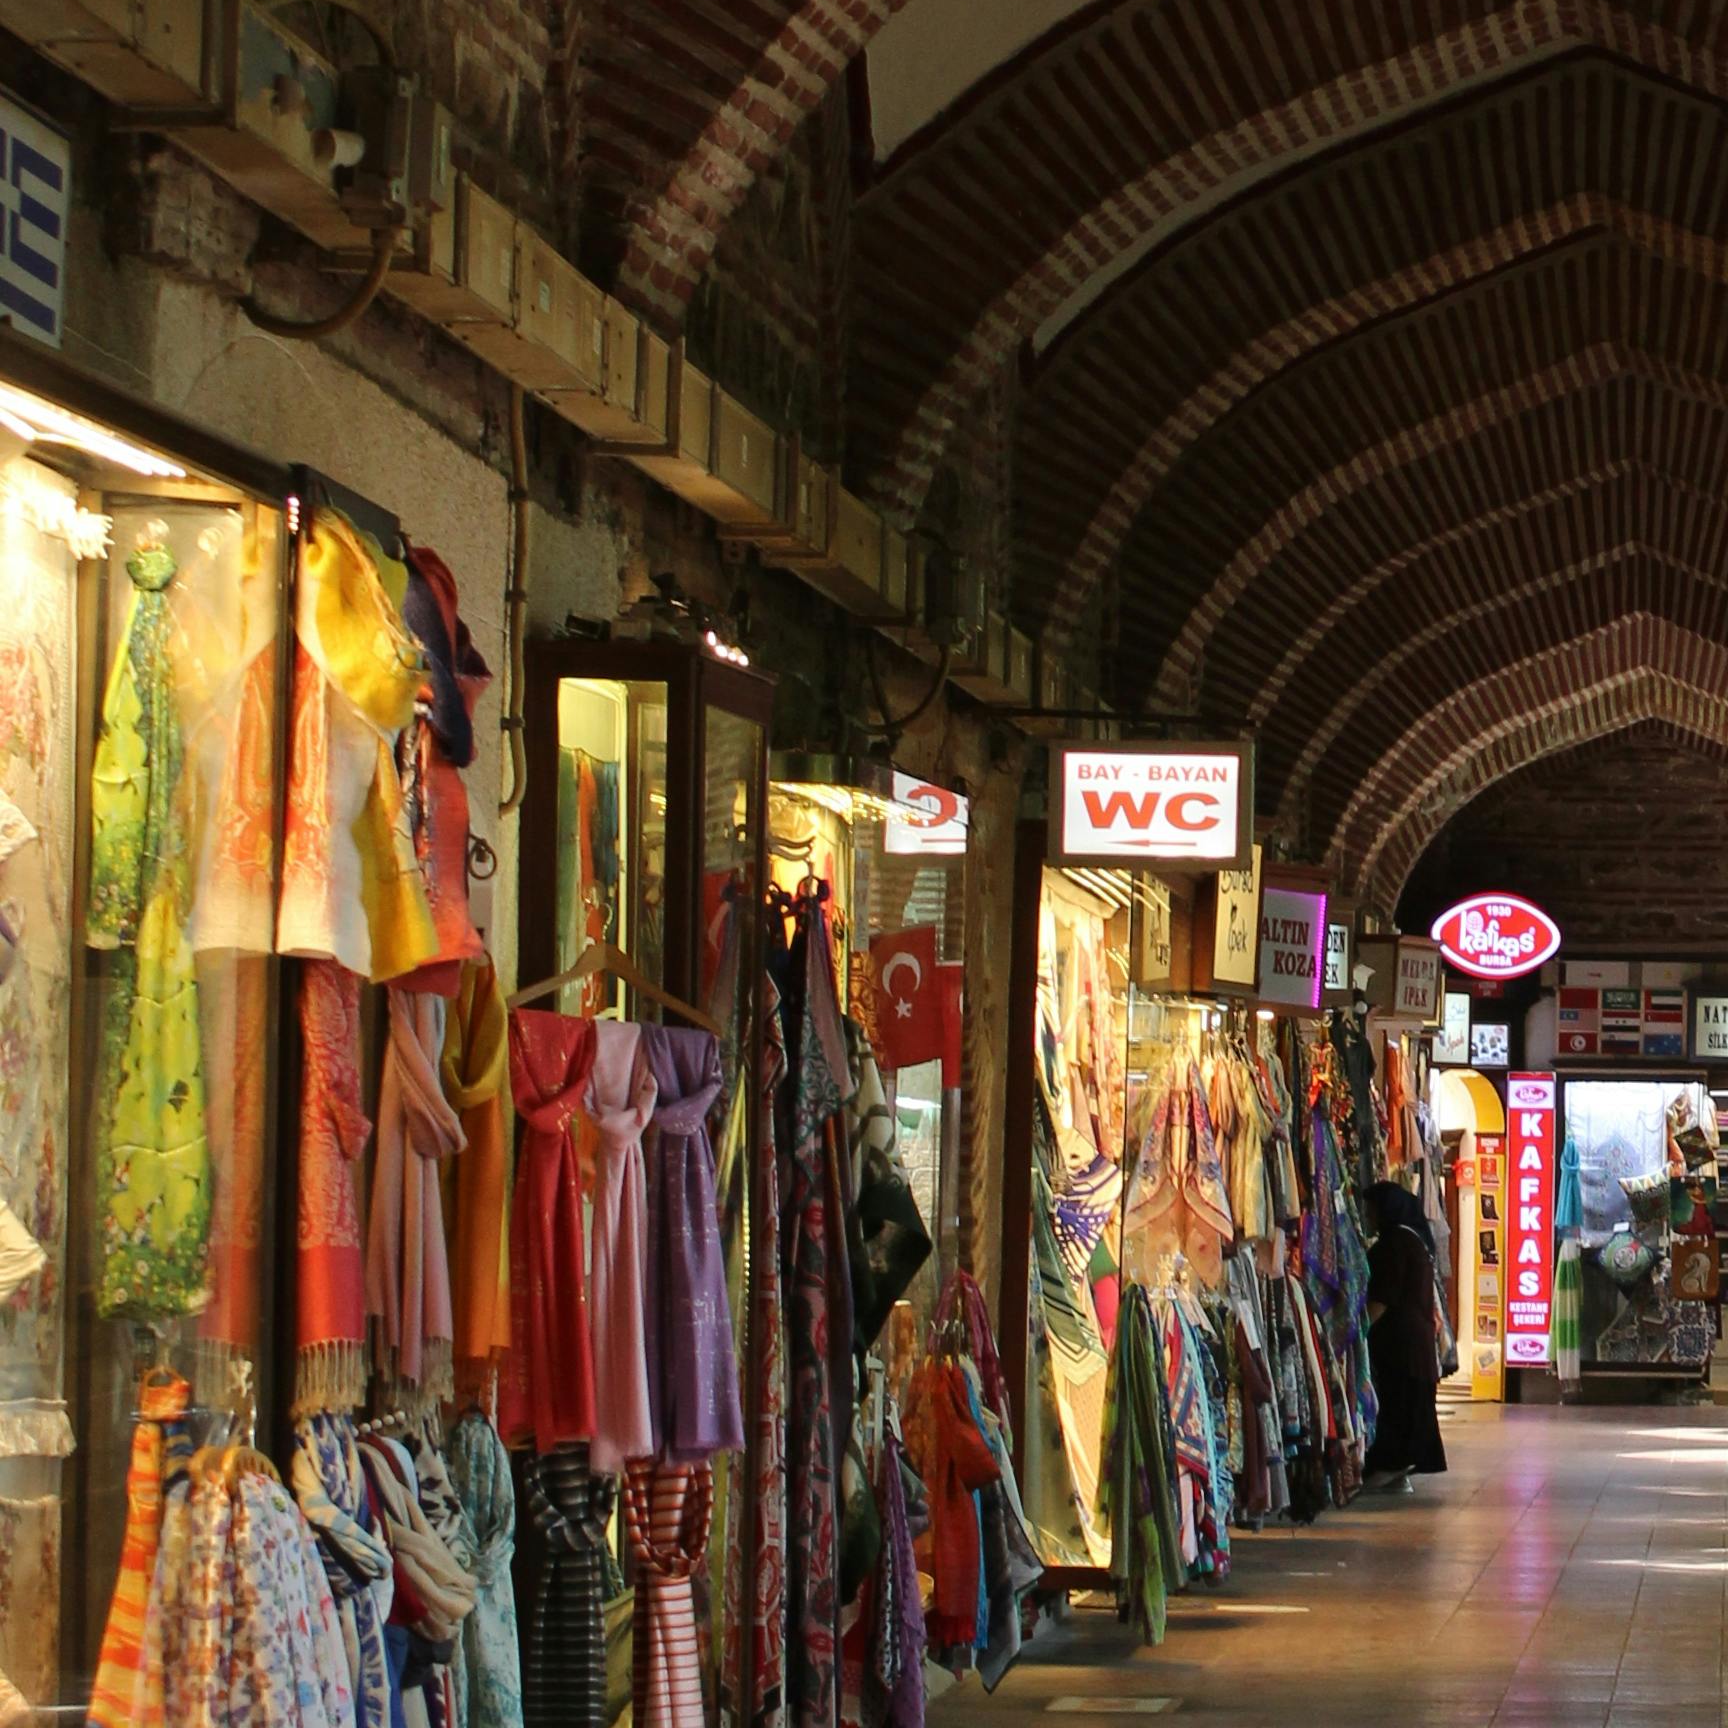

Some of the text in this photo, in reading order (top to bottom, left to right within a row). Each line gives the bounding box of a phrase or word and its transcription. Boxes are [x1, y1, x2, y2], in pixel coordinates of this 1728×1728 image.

[1078, 764, 1122, 780] BAY
[1148, 765, 1228, 782] BAYAN
[1081, 790, 1220, 831] WC
[1261, 917, 1310, 946] ALTIN
[1273, 950, 1317, 979] KOZA
[1479, 954, 1512, 967] BURSA
[1518, 1112, 1543, 1297] KAFKAS
